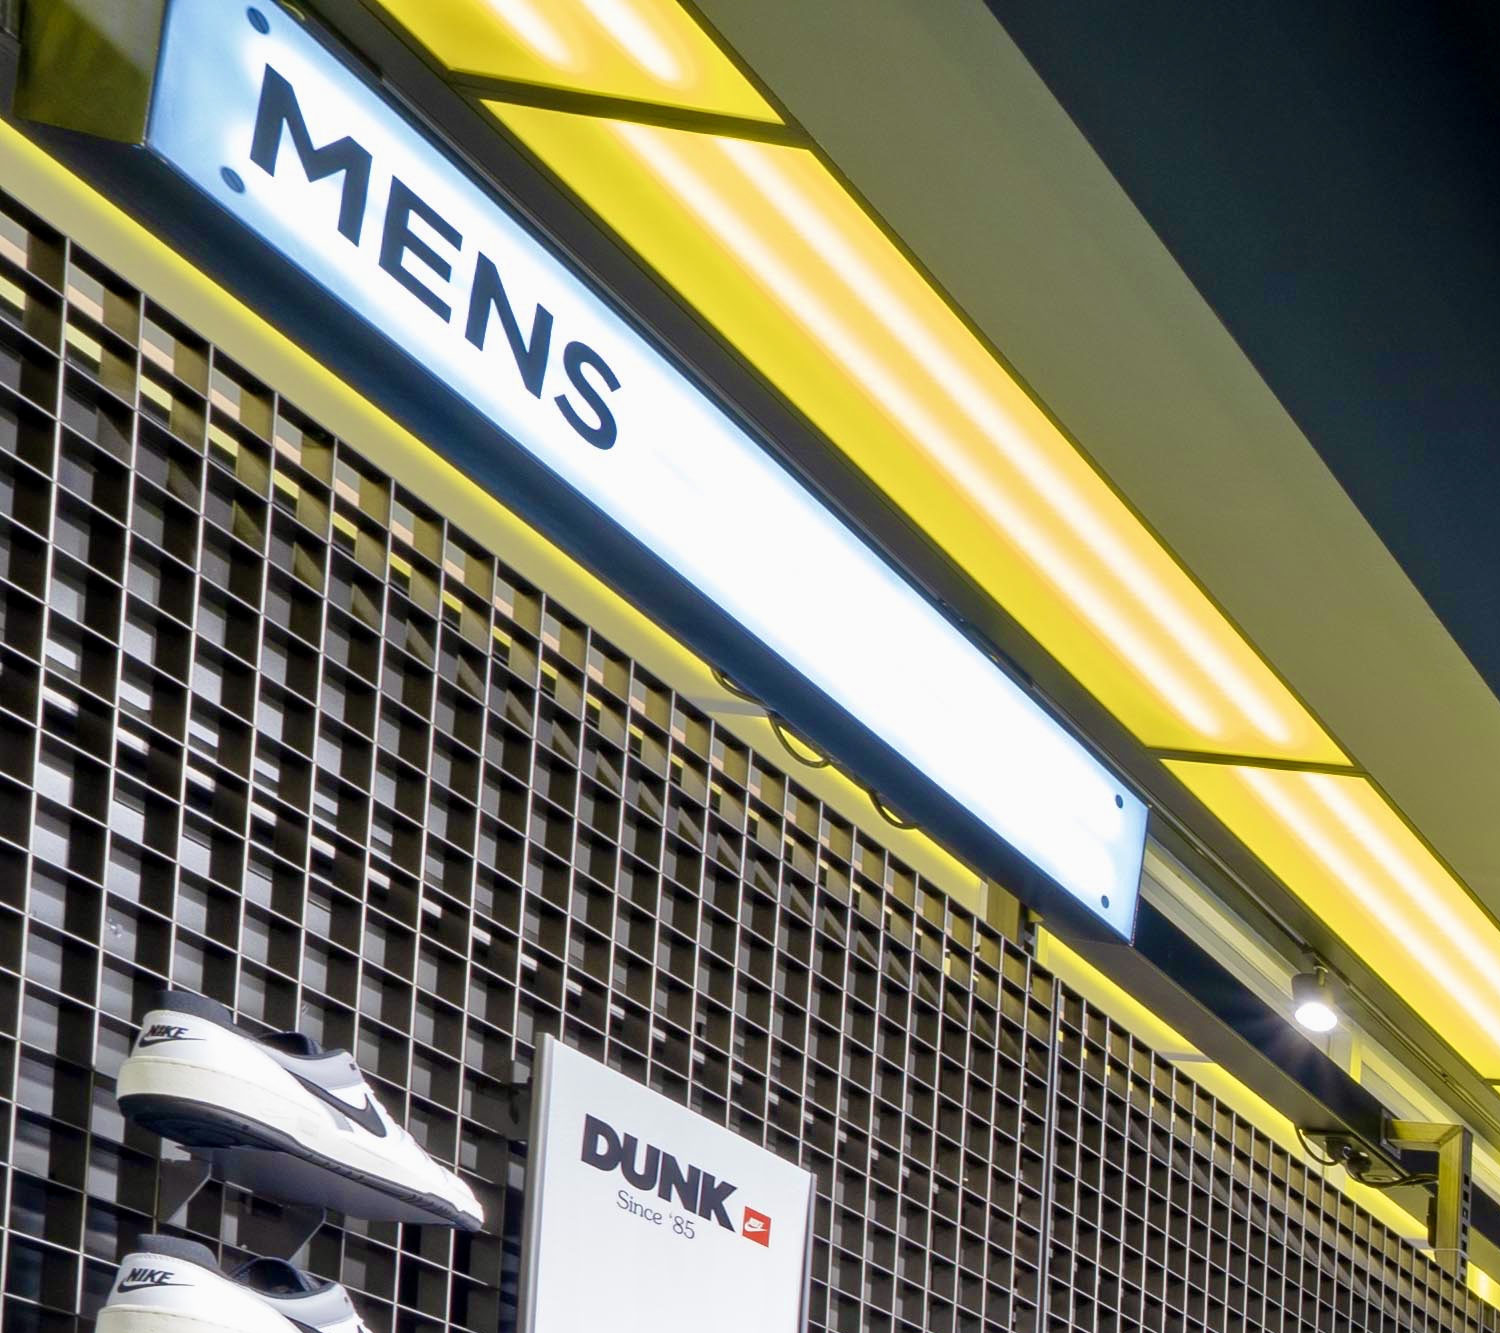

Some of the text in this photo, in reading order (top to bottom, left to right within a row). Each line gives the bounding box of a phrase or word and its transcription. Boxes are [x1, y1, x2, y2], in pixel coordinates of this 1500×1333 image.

[249, 63, 620, 450] MENS
[148, 1024, 189, 1040] NIKE
[580, 1113, 738, 1232] DUNK
[616, 1190, 663, 1225] Since
[129, 1268, 175, 1284] NIKE
